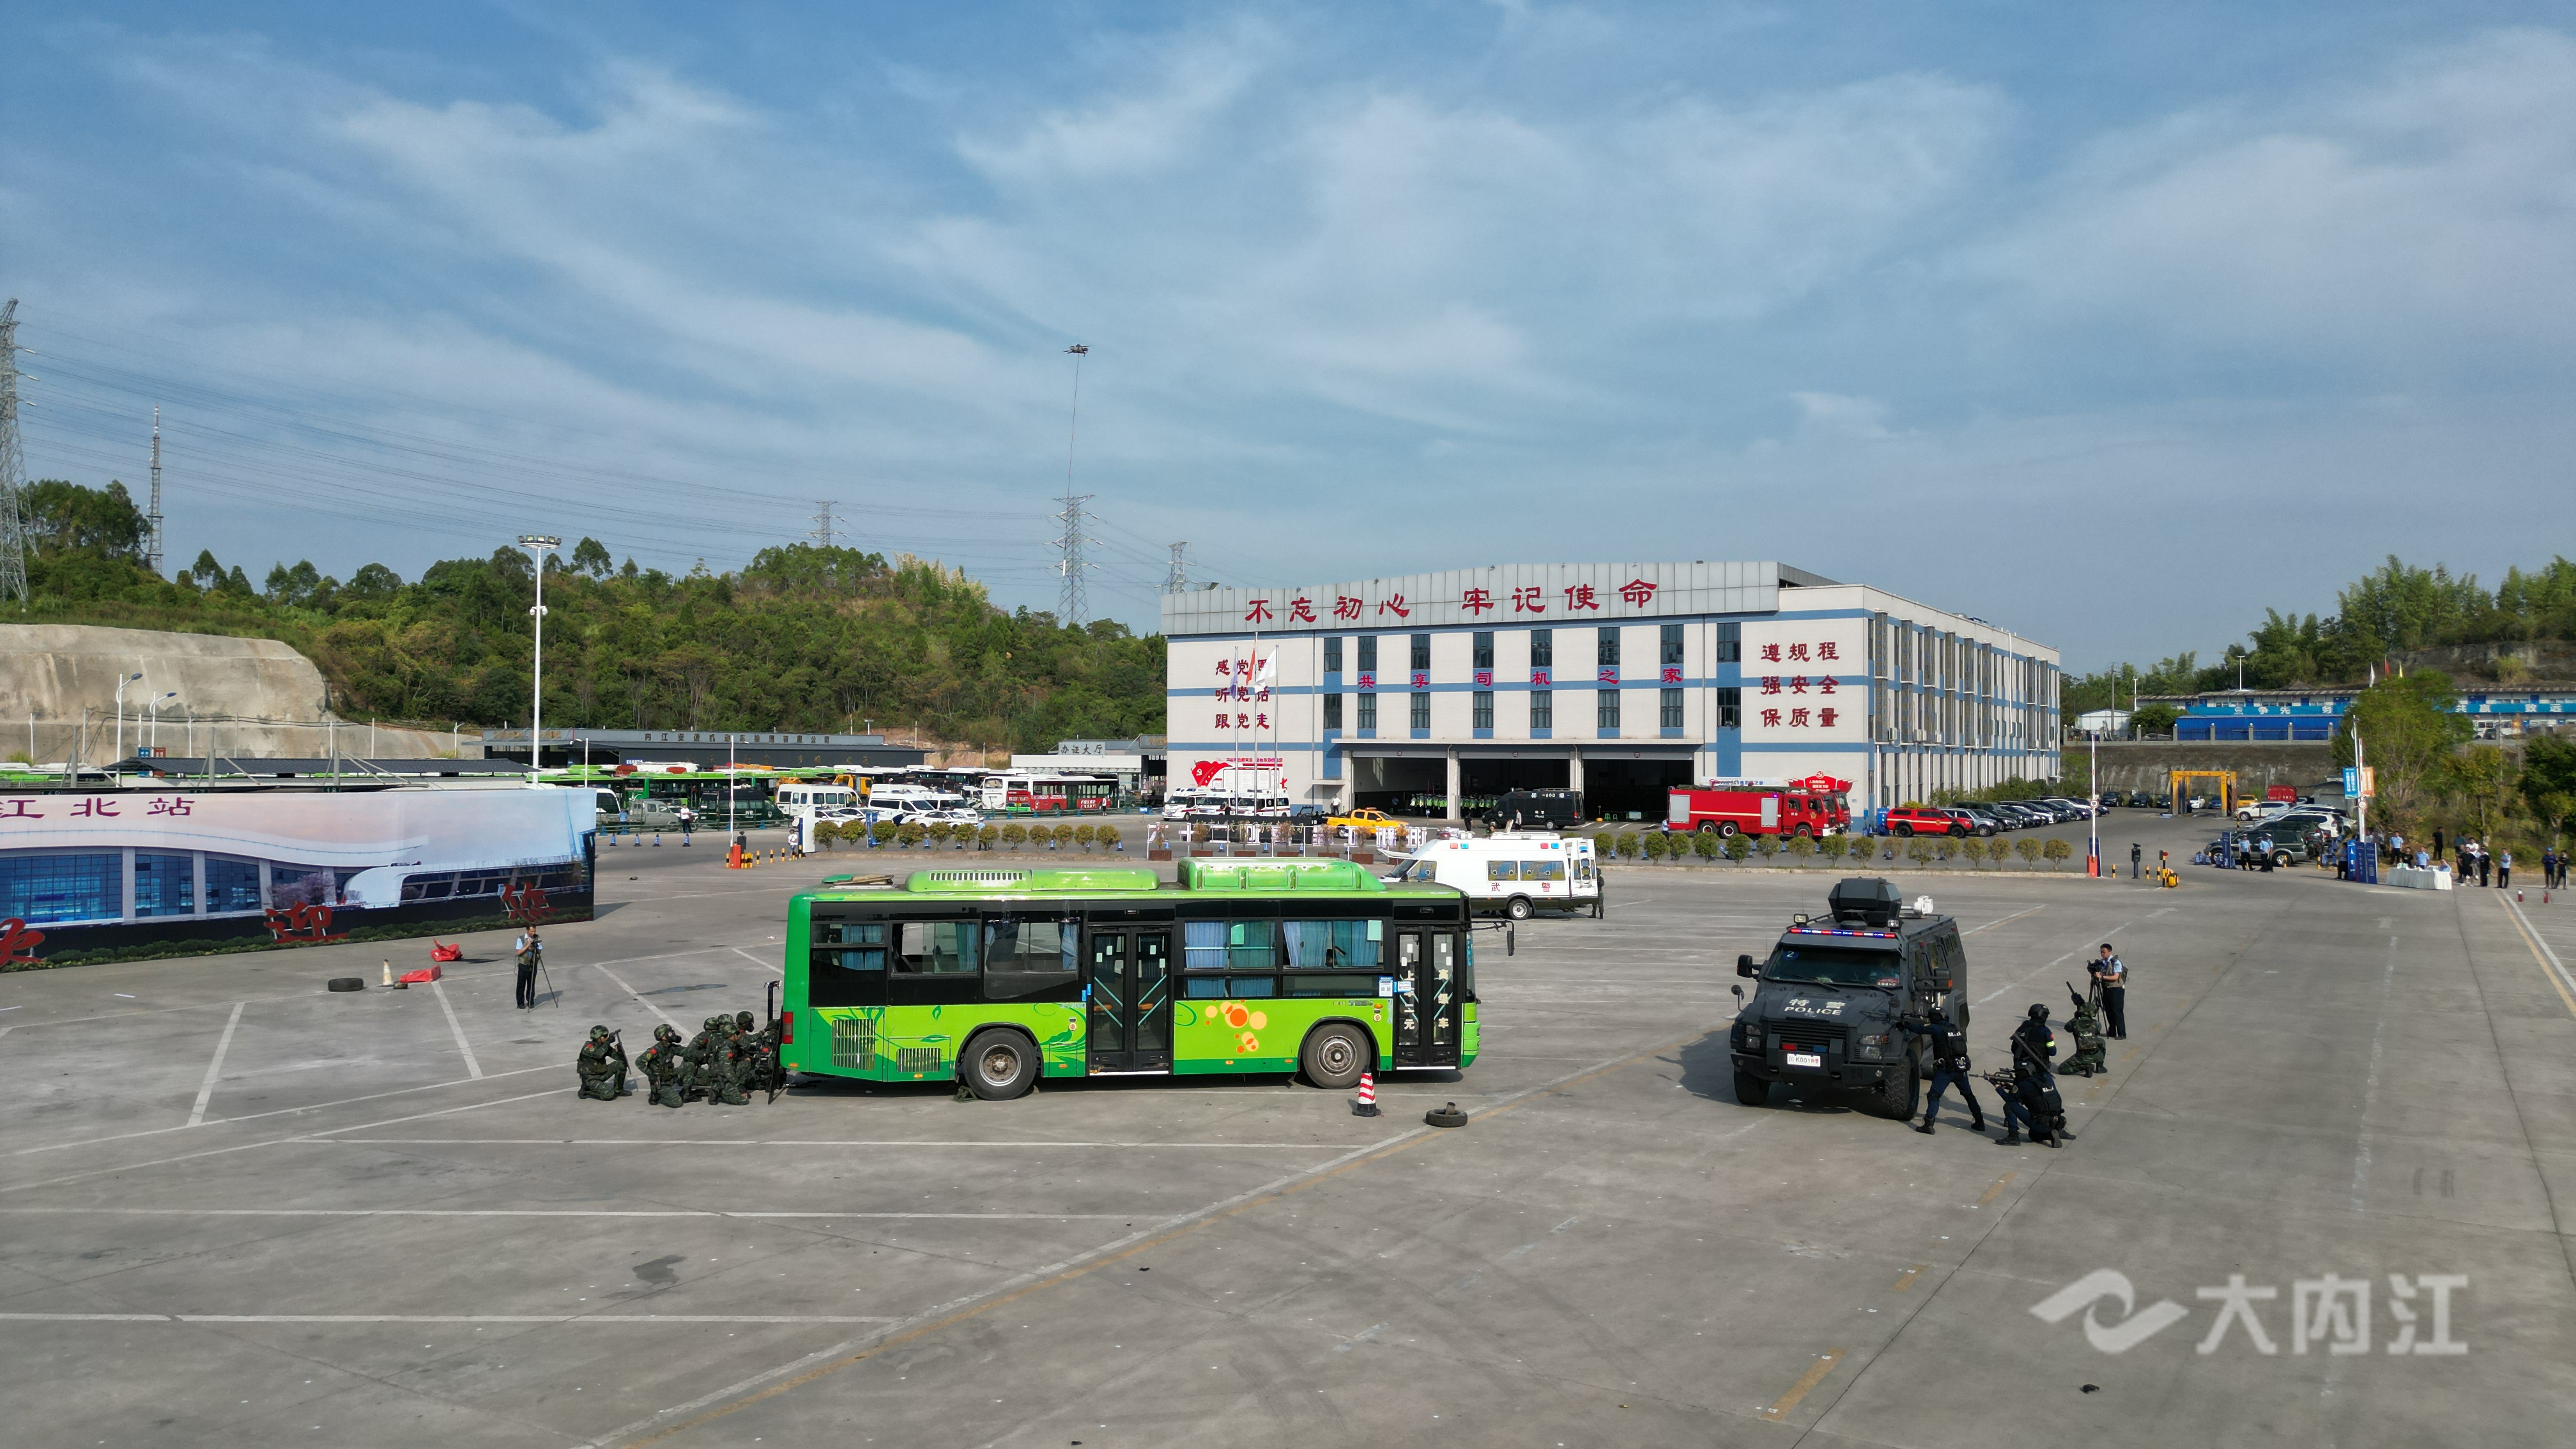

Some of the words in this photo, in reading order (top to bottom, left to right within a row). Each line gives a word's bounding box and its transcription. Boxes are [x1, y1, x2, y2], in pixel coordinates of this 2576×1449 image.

[1245, 592, 1410, 624] 不忘初心
[1462, 578, 1659, 615] 牢记使命
[1761, 641, 1839, 663] 遵规程
[1359, 668, 1682, 689] 共享司机之家
[1761, 675, 1839, 695] 强安全
[1215, 712, 1270, 730] 跟党走
[1760, 707, 1839, 727] 保质量
[1060, 743, 1103, 755] 办证大厅
[0, 797, 195, 819] 江北站
[1491, 882, 1551, 893] 武警
[1784, 1006, 1843, 1015] POLICE
[1789, 999, 1846, 1009] 特警
